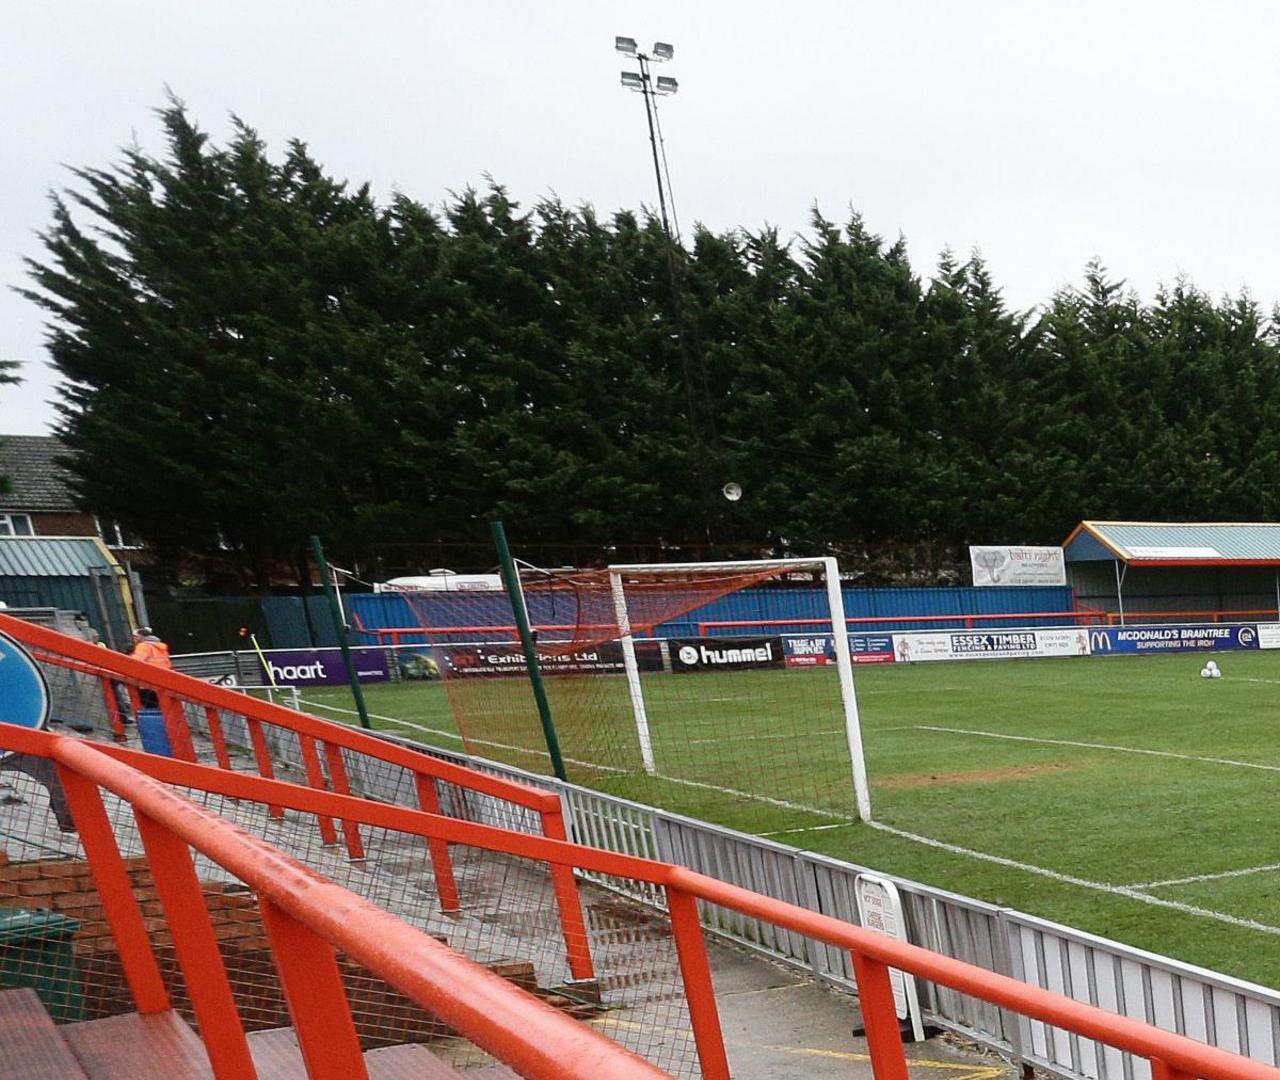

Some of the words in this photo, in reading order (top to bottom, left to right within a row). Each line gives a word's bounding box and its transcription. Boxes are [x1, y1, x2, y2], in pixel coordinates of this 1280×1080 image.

[952, 635, 988, 646] ESSEX
[989, 633, 1035, 645] TIMBER
[1118, 630, 1179, 640] MCDONALD'S
[1181, 628, 1231, 639] BRAINTREE
[952, 645, 986, 653] FENCING
[993, 643, 1022, 651] PAVING
[1023, 642, 1037, 650] LTD
[1137, 640, 1180, 649] SUPPORTING
[1182, 640, 1196, 648] THE
[574, 652, 598, 662] Ltd
[701, 643, 773, 664] hummel
[269, 660, 327, 680] haart
